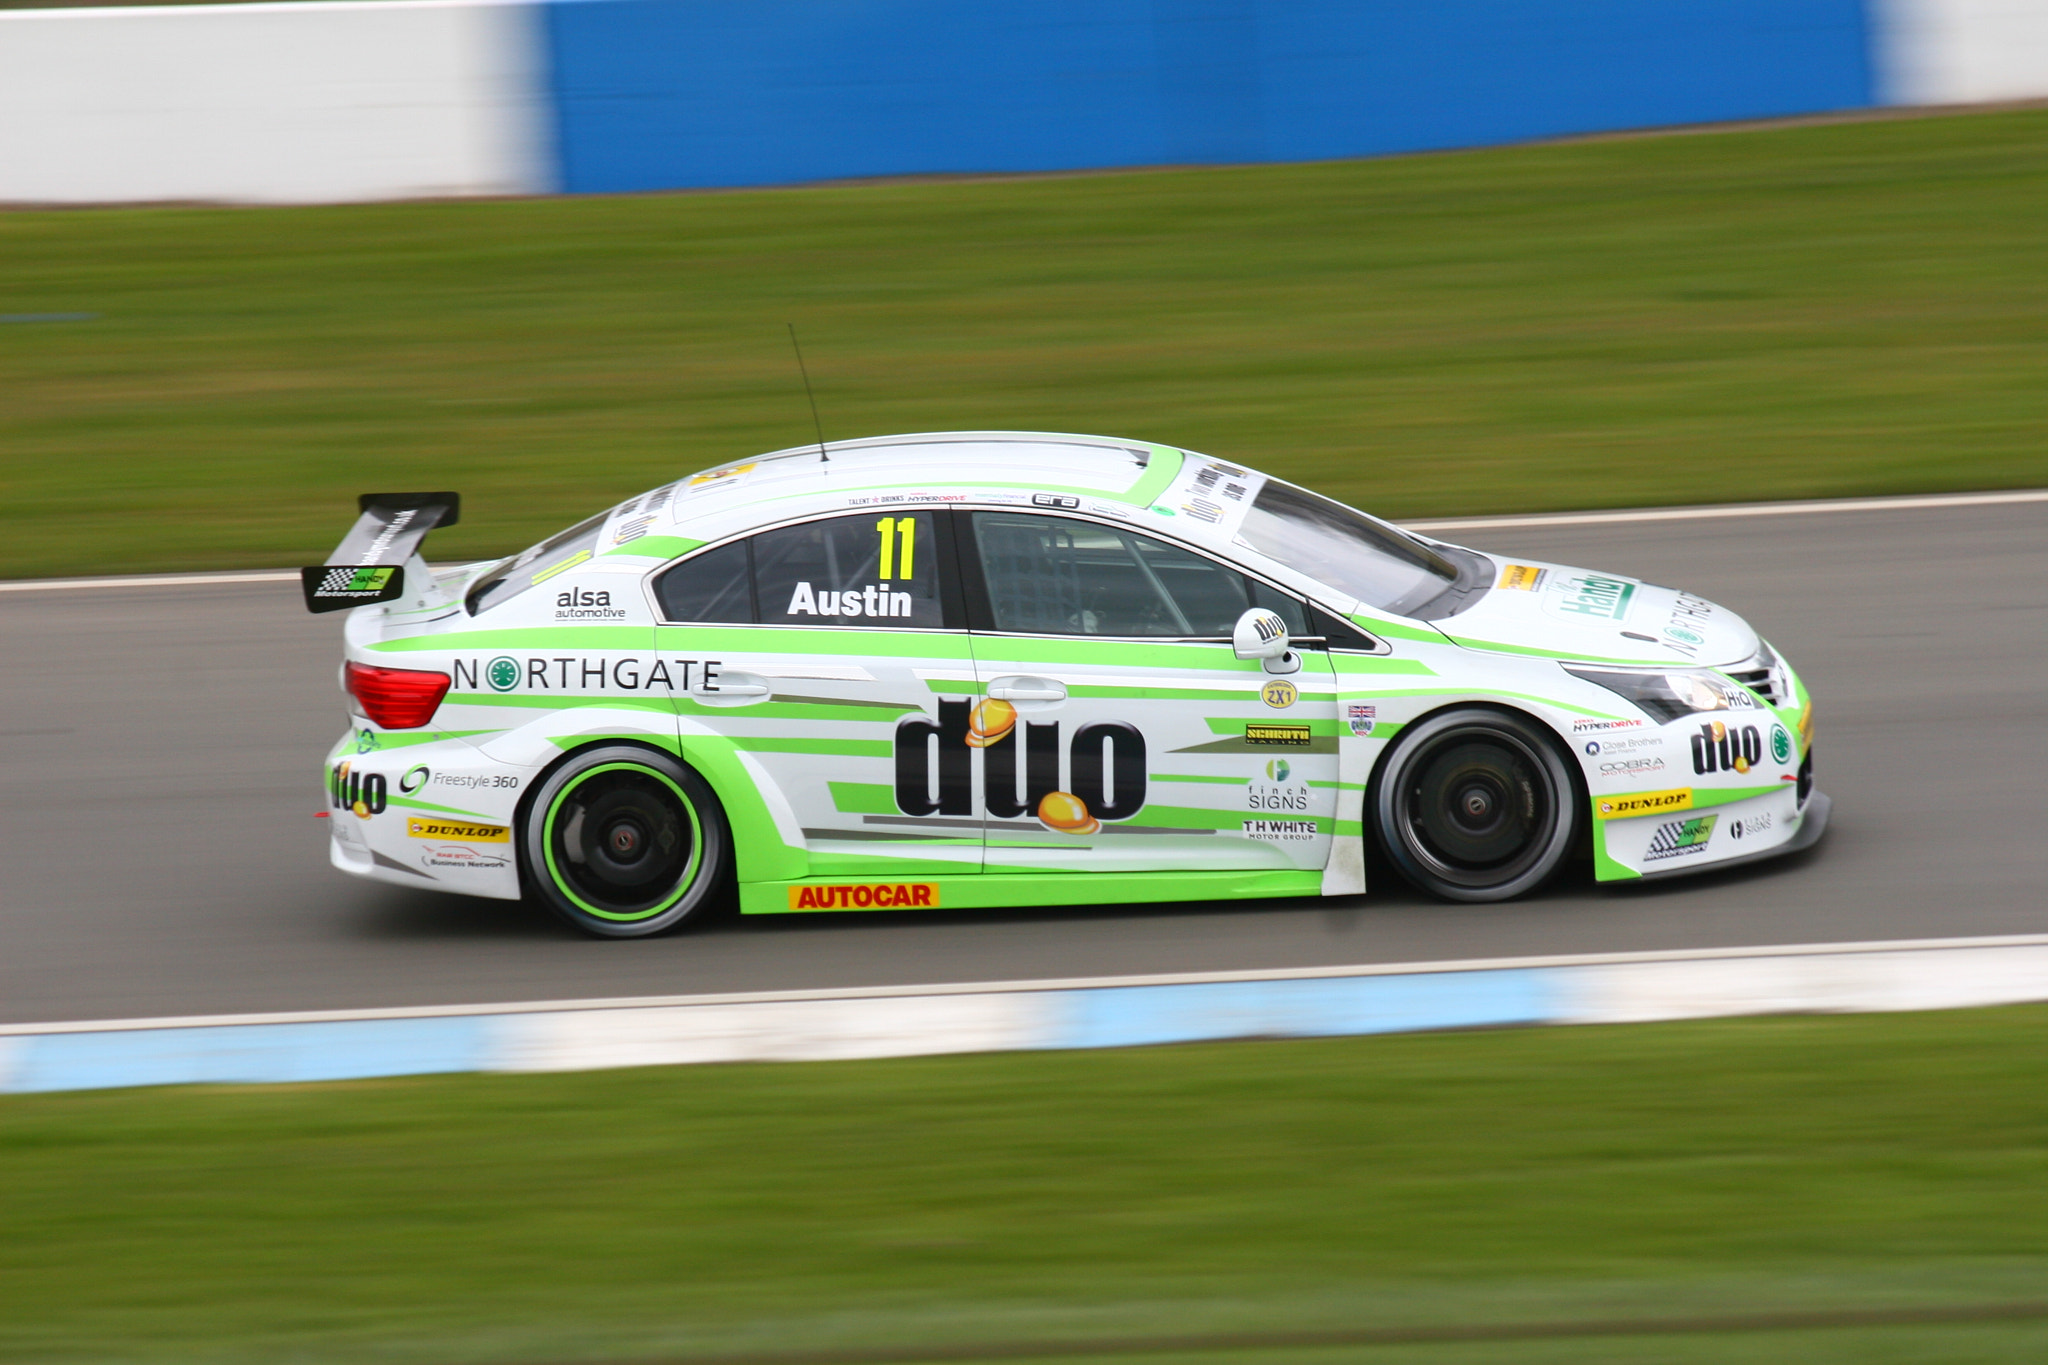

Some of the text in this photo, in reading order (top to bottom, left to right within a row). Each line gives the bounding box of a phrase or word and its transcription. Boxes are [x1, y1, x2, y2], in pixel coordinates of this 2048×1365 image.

[908, 495, 967, 503] HYPERDRIVE
[1035, 494, 1077, 507] era
[877, 517, 916, 580] 11
[314, 590, 382, 598] Motorsport
[557, 586, 611, 607] alsa
[787, 582, 912, 618] Austin
[555, 608, 626, 618] automotive
[1253, 616, 1285, 641] duo
[453, 656, 722, 692] NORTHGATE
[1267, 690, 1291, 704] ZX1
[1727, 690, 1751, 707] HiQ
[1573, 719, 1643, 732] HYPERDRIVE
[1602, 737, 1663, 750] Close Brothers
[1691, 722, 1761, 775] duo
[894, 697, 1147, 824] duo
[1600, 757, 1665, 772] COBRA
[433, 772, 519, 789] Freestyle 360
[1248, 785, 1307, 795] finch
[1248, 795, 1307, 810] SIGNS
[1616, 793, 1687, 811] DUNLOP
[426, 825, 504, 837] DUNLOP
[1269, 821, 1317, 833] WHITE
[430, 858, 505, 868] Business Network
[797, 884, 931, 908] AUTOCAR
